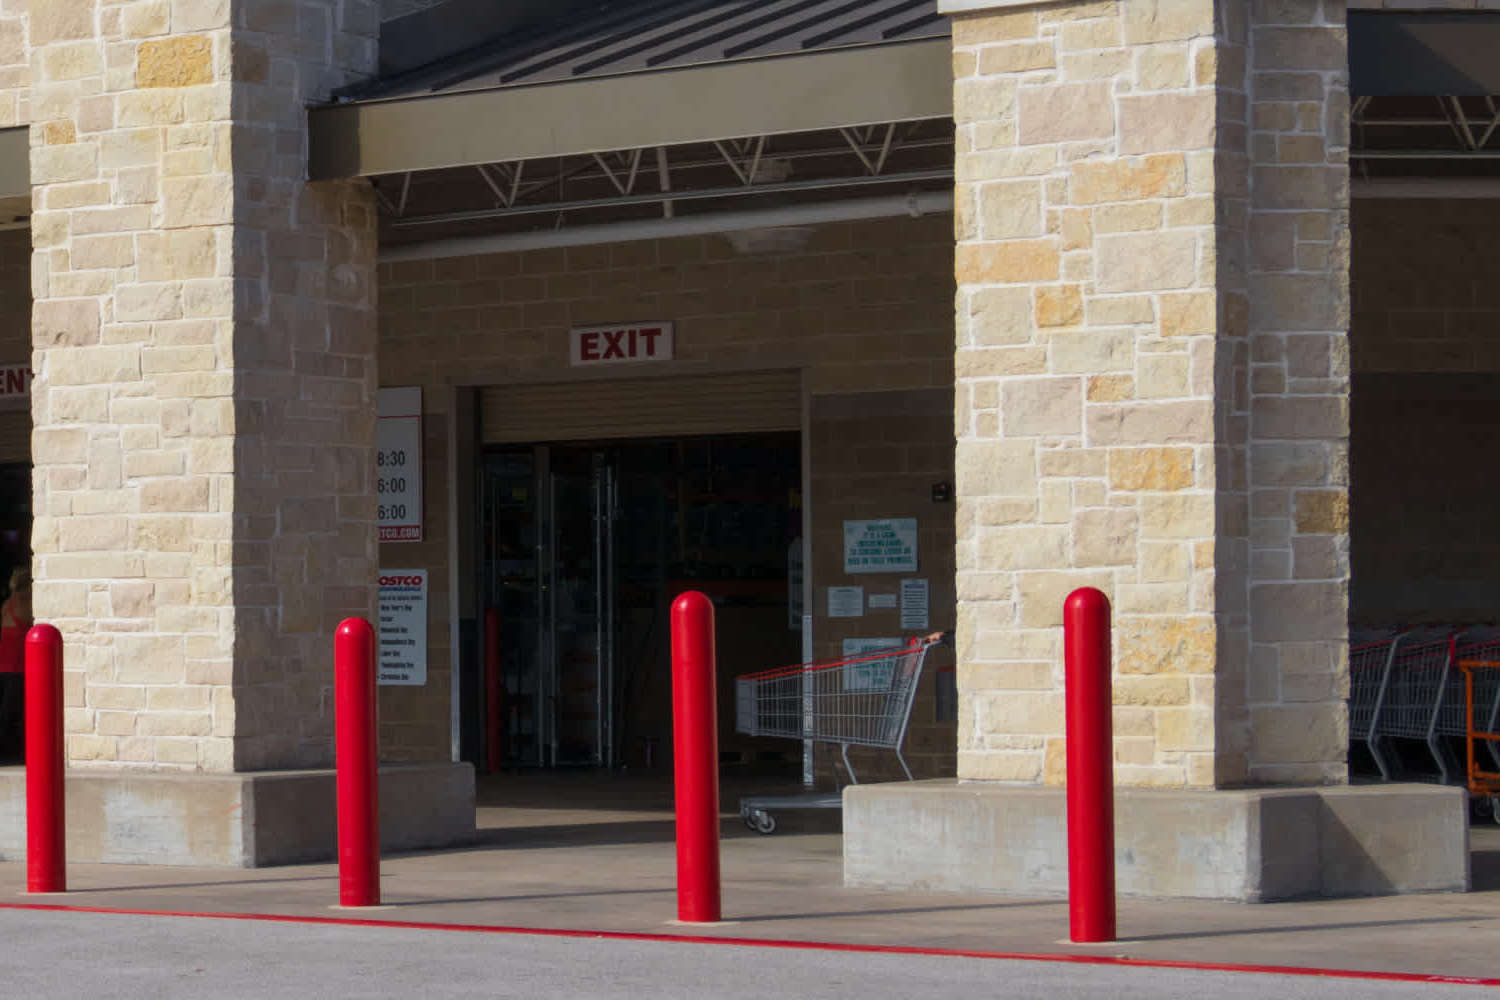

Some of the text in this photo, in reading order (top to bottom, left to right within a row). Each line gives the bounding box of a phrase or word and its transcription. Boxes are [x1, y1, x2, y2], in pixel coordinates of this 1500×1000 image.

[580, 327, 662, 360] EXIT
[377, 450, 405, 467] 8:30
[378, 478, 406, 494] 6:00
[378, 505, 406, 520] 6:00
[378, 575, 423, 586] OSTCO
